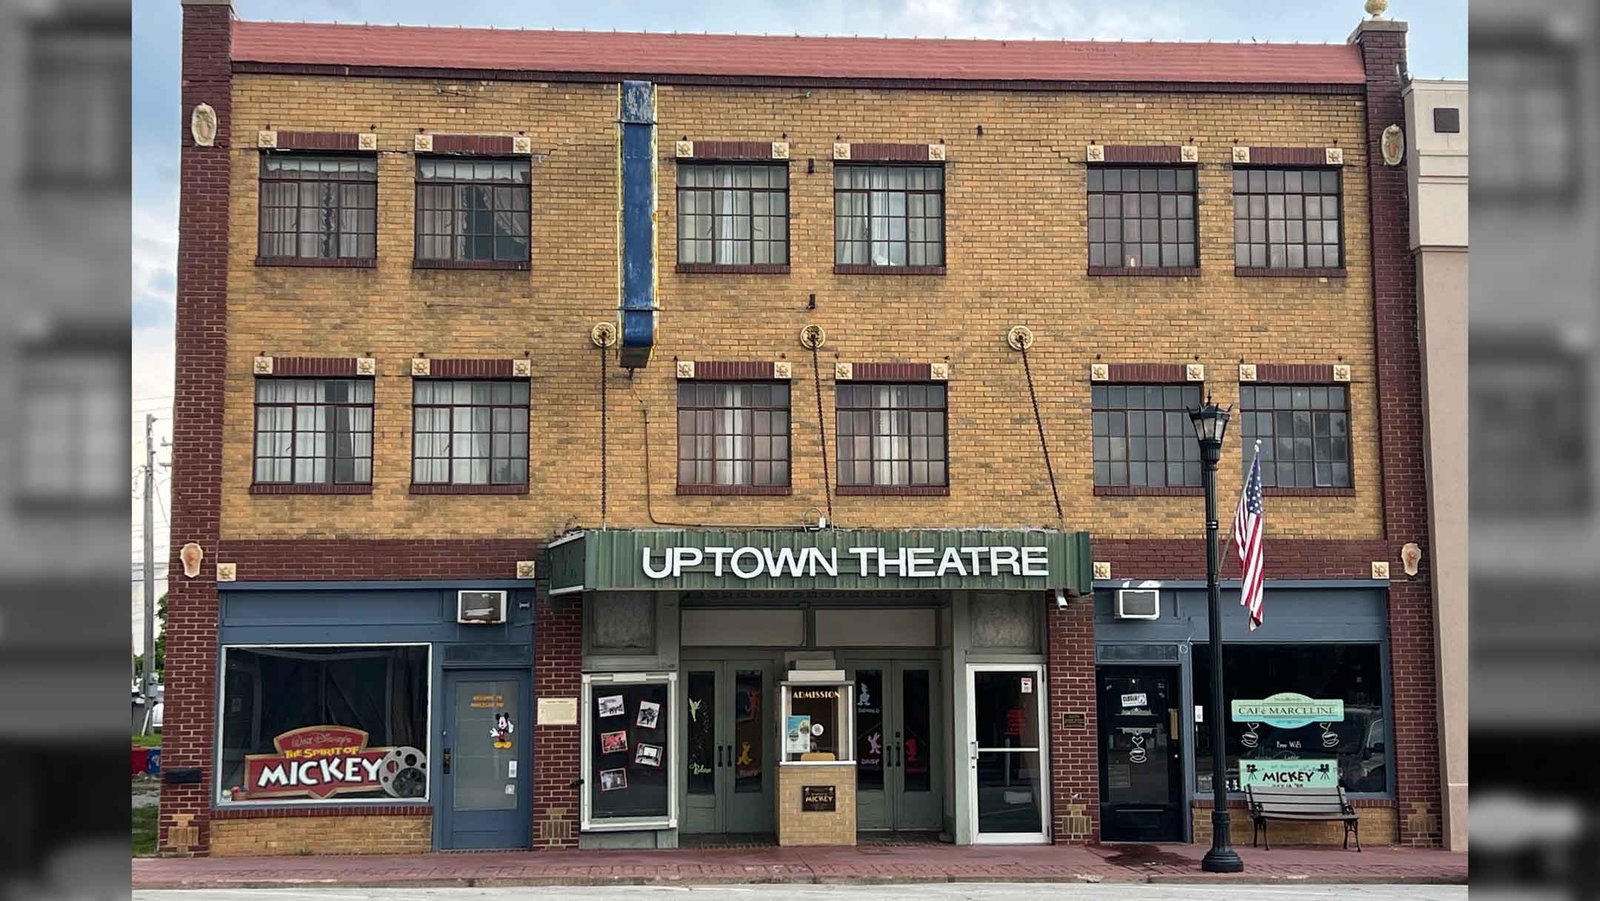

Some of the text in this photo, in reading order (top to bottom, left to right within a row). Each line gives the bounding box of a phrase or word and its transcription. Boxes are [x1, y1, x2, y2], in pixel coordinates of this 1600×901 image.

[642, 546, 1049, 579] UPTOWN THEATRE
[793, 691, 840, 699] ADMISSION
[1269, 706, 1335, 715] MARCELINE
[284, 746, 360, 759] THE SPIRIT OF
[257, 757, 383, 788] MICKEY
[1262, 771, 1315, 783] MICKEY
